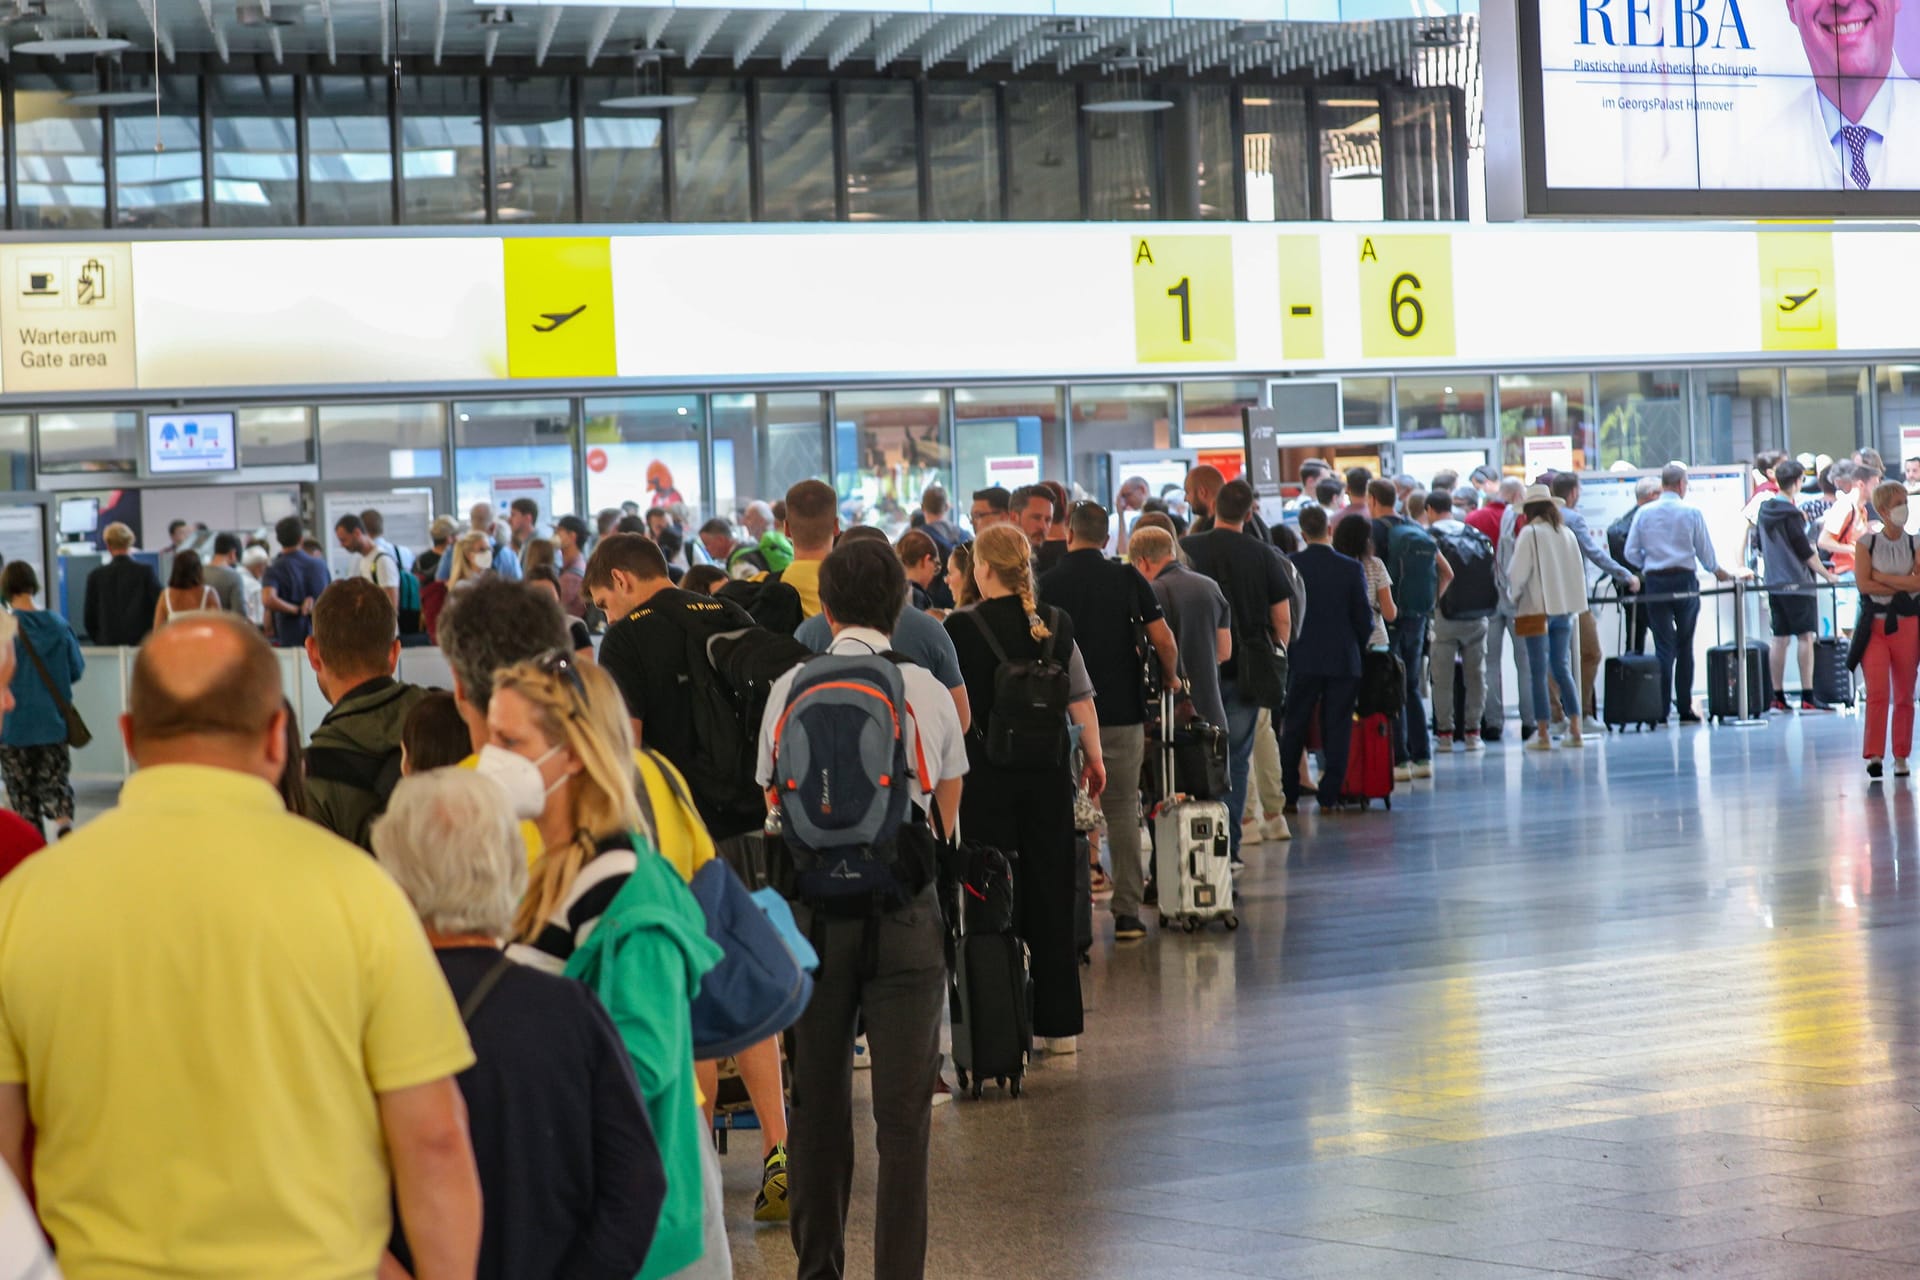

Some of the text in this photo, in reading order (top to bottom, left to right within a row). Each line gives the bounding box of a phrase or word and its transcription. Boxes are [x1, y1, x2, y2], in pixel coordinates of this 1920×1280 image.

[1574, 0, 1756, 50] REBA
[1573, 58, 1757, 79] Plastische und Ästhetische Chirurgie
[1602, 97, 1734, 113] im GeorgsPalast Hannover
[1136, 240, 1153, 264] A
[1361, 238, 1377, 262] A
[1168, 277, 1191, 342] 1
[1390, 273, 1423, 337] 6
[19, 327, 117, 345] Warteraum
[20, 350, 107, 369] Gate area
